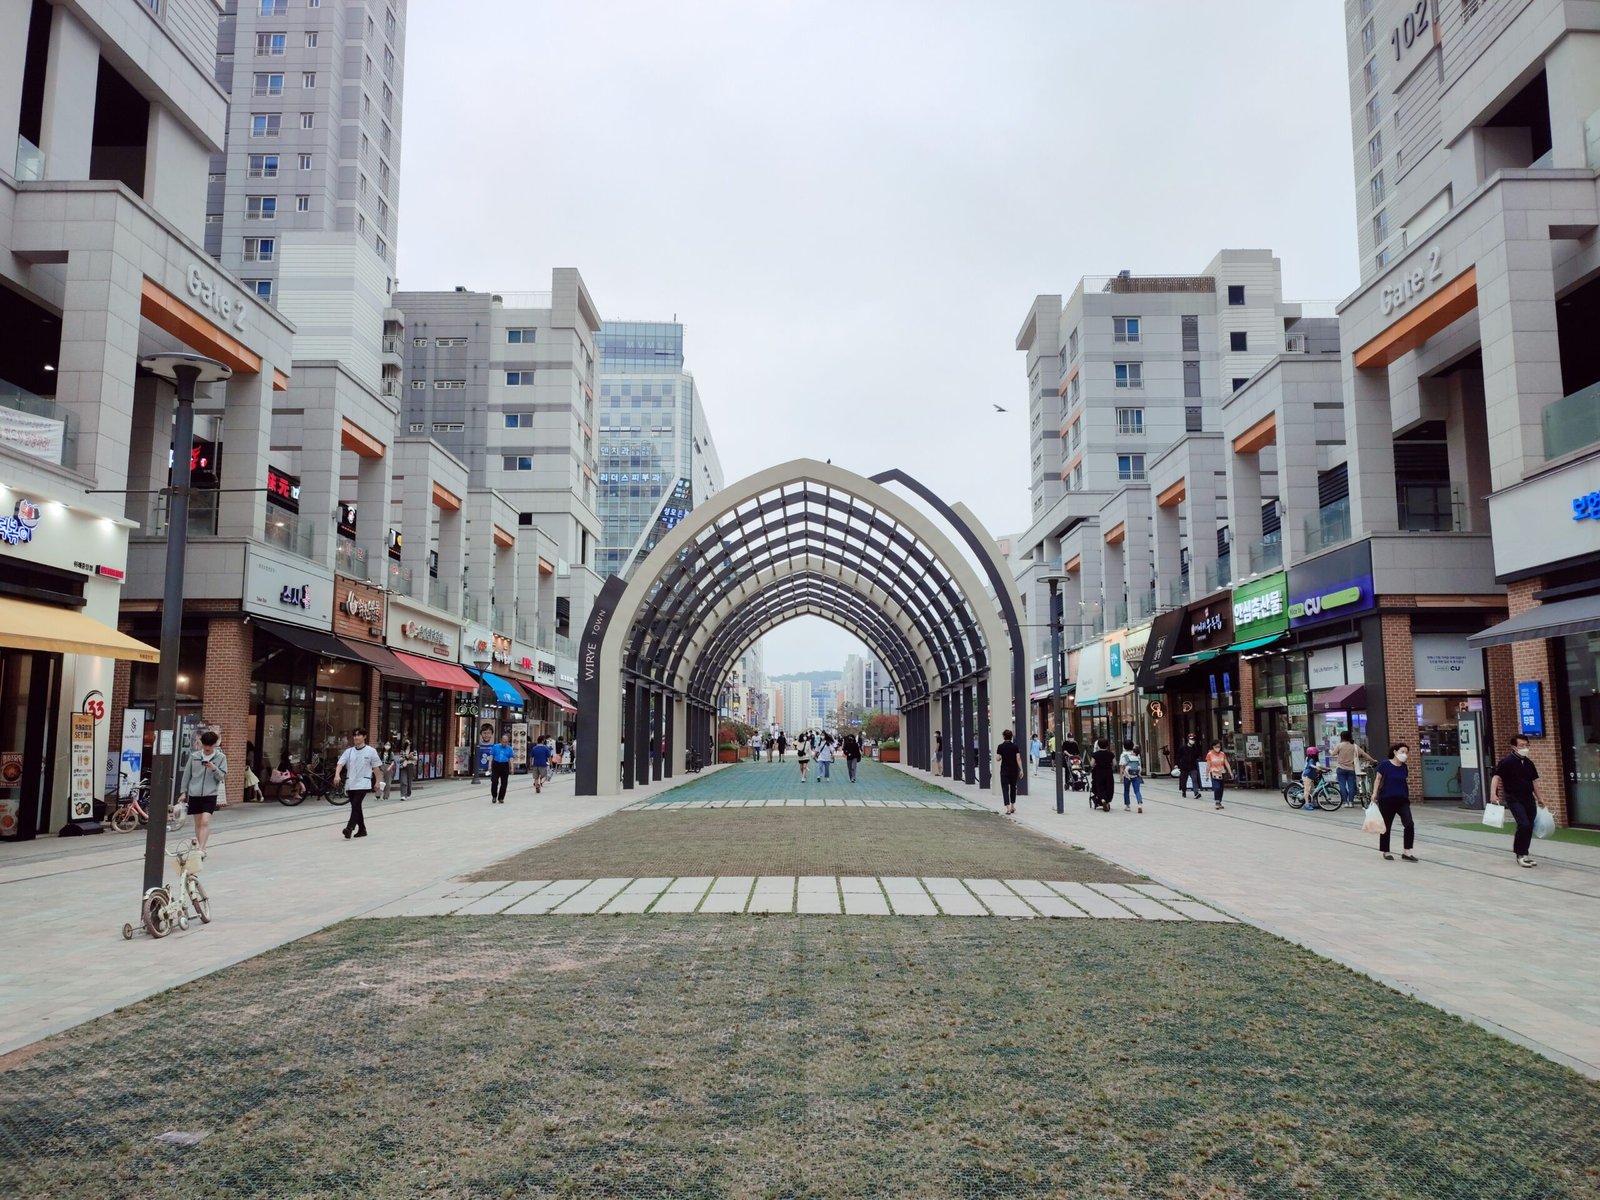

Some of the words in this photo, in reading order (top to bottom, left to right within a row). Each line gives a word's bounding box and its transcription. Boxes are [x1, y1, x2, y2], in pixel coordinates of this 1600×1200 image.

[1391, 0, 1429, 61] 102
[186, 263, 231, 320] Gate
[231, 300, 246, 332] 2
[1380, 268, 1425, 316] Gate
[1428, 246, 1443, 282] 2
[600, 473, 660, 482] 리더스피부과
[1305, 596, 1320, 616] CU
[585, 642, 597, 681] WIRYE
[592, 609, 606, 636] TOWN
[88, 700, 104, 720] 33
